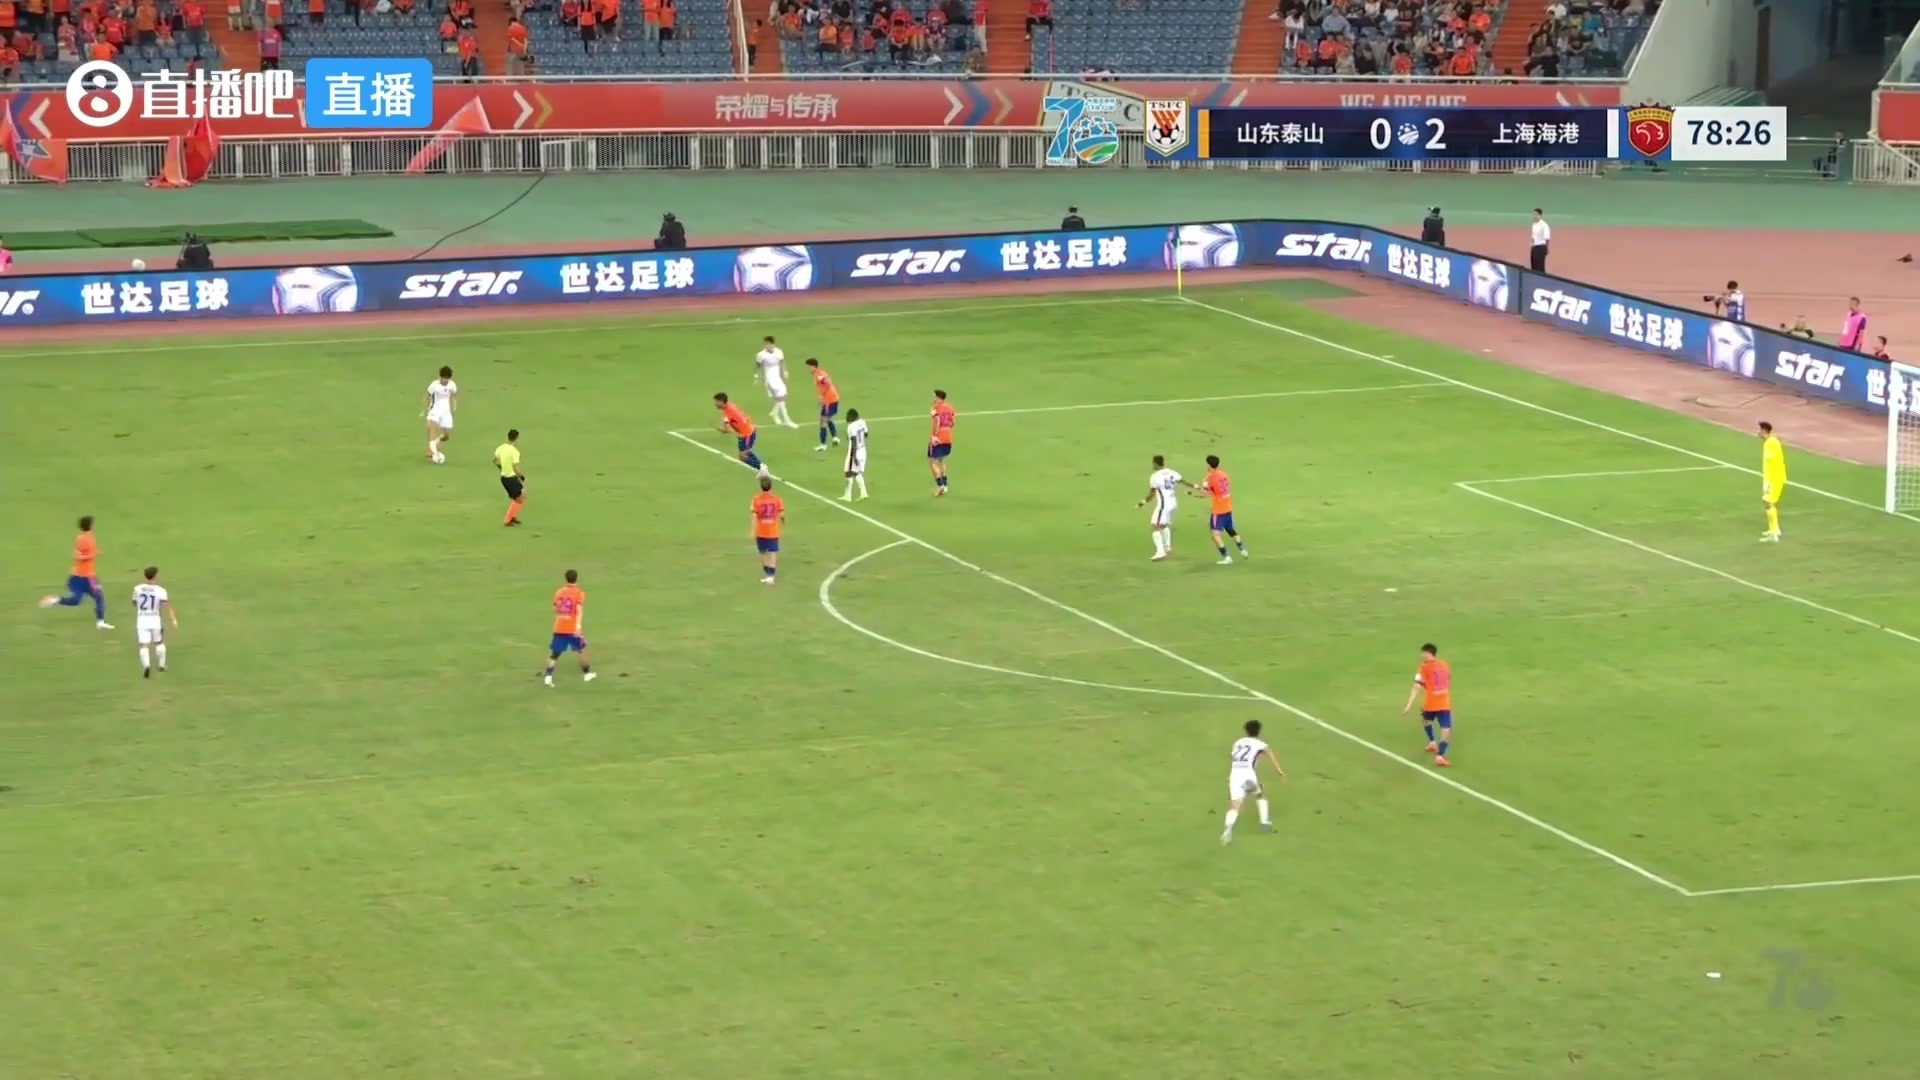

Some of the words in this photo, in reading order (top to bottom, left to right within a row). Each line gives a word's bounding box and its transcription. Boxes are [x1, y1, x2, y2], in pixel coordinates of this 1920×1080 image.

[715, 92, 838, 122] 荣耀与传承
[1000, 236, 1127, 271] 世达足球
[1387, 243, 1451, 288] 世达足球
[560, 257, 694, 293] 世达足球
[81, 278, 229, 315] 世达足球
[1609, 303, 1683, 350] 世达足球
[139, 593, 156, 611] 21
[1232, 744, 1251, 762] 22
